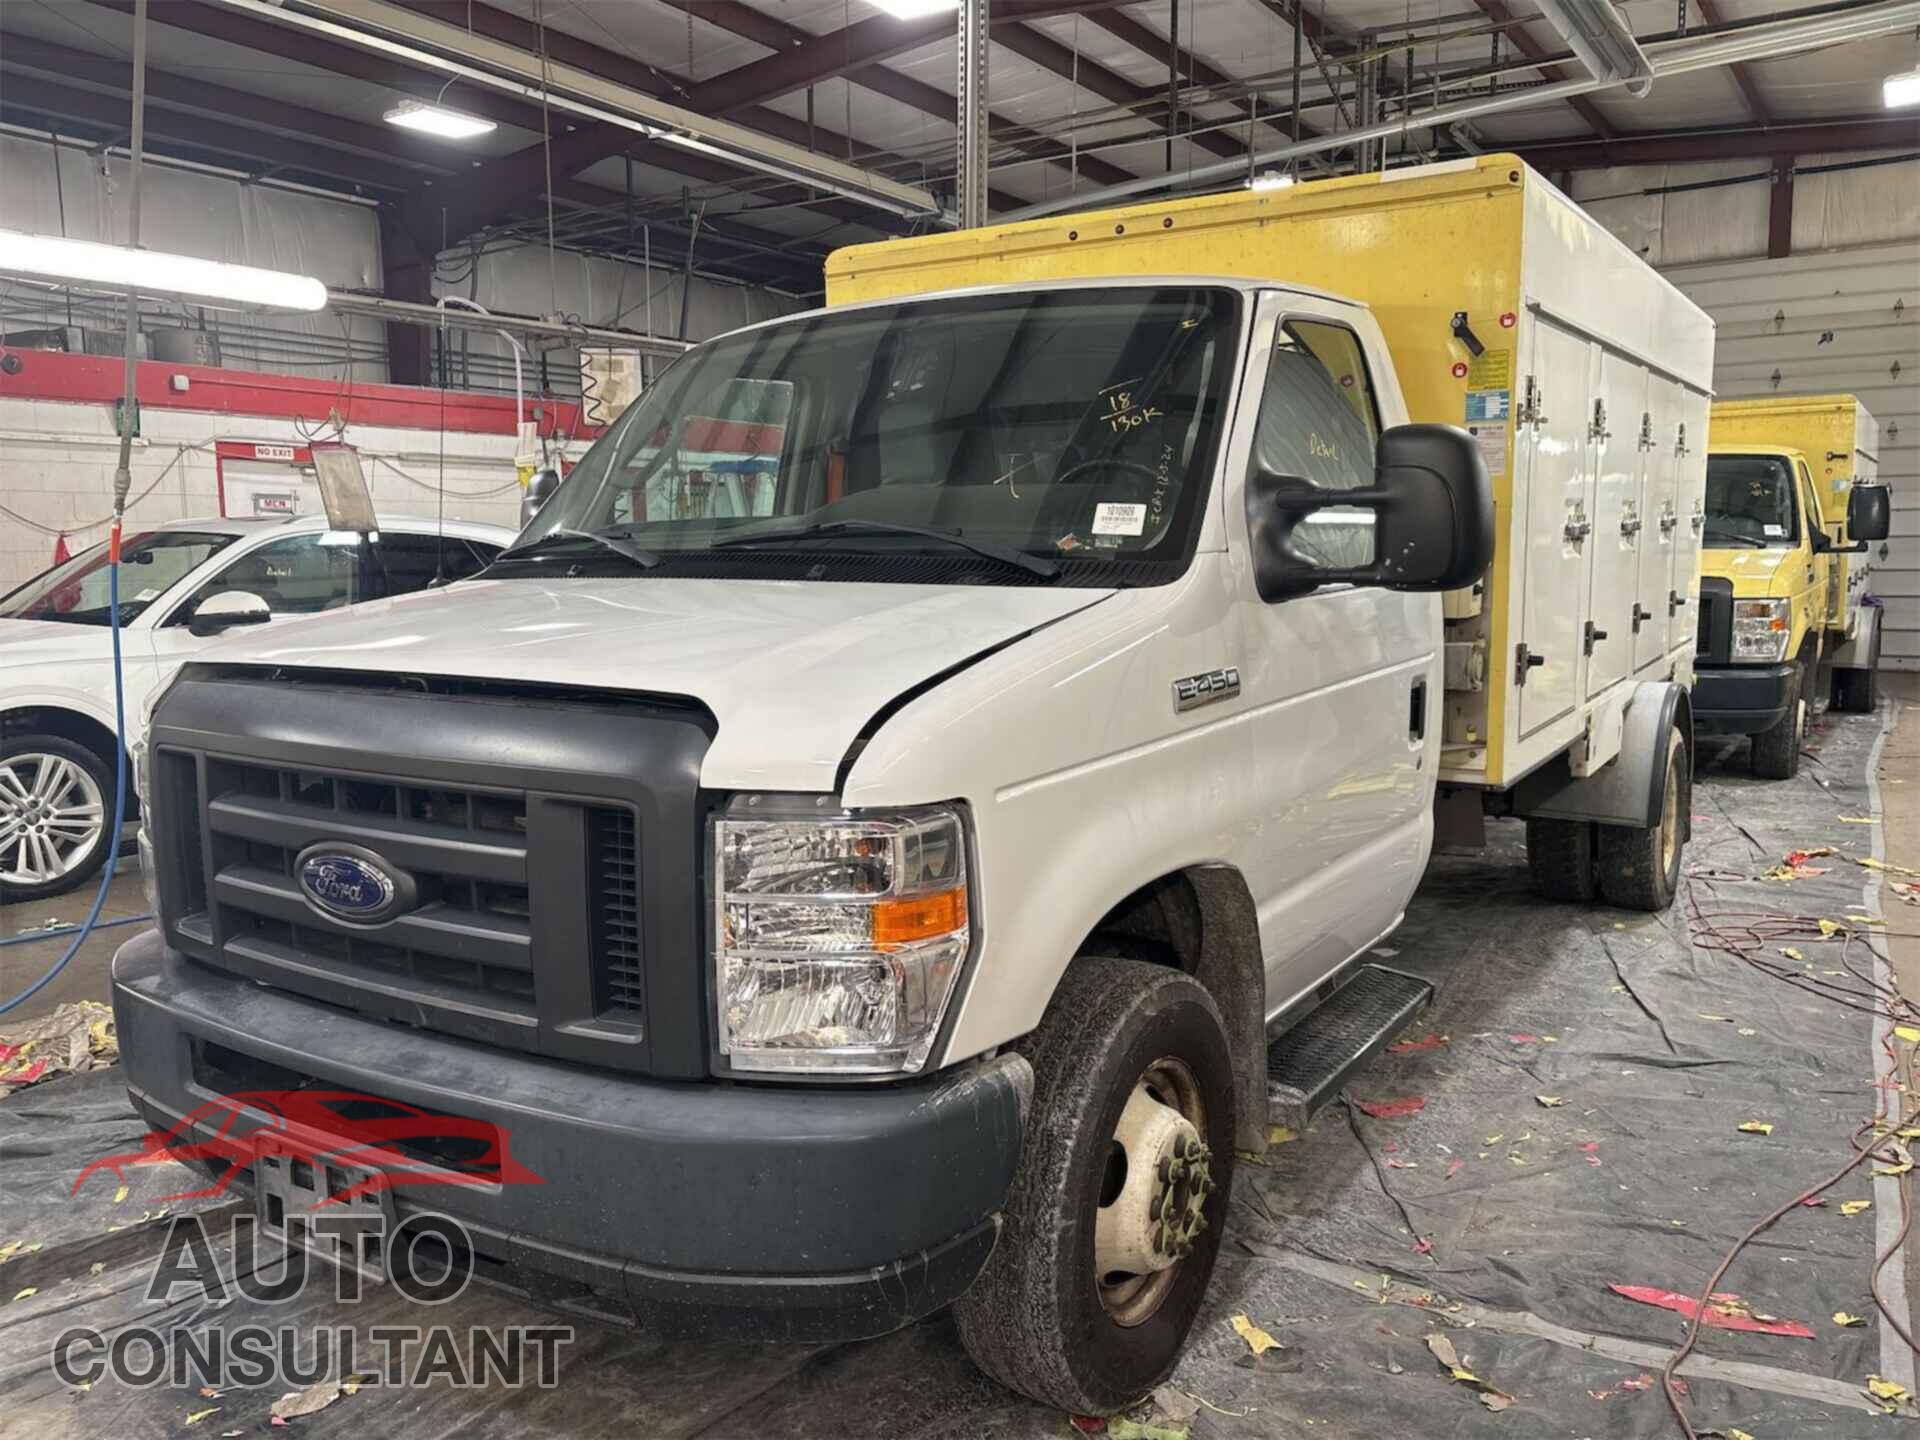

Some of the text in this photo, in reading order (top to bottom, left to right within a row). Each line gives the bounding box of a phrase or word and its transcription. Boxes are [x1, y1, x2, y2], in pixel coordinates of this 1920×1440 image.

[1110, 392, 1132, 411] 18
[1111, 407, 1165, 432] 130K
[257, 447, 292, 458] NO EXIT
[1173, 666, 1240, 704] E-450
[314, 863, 363, 902] Ford
